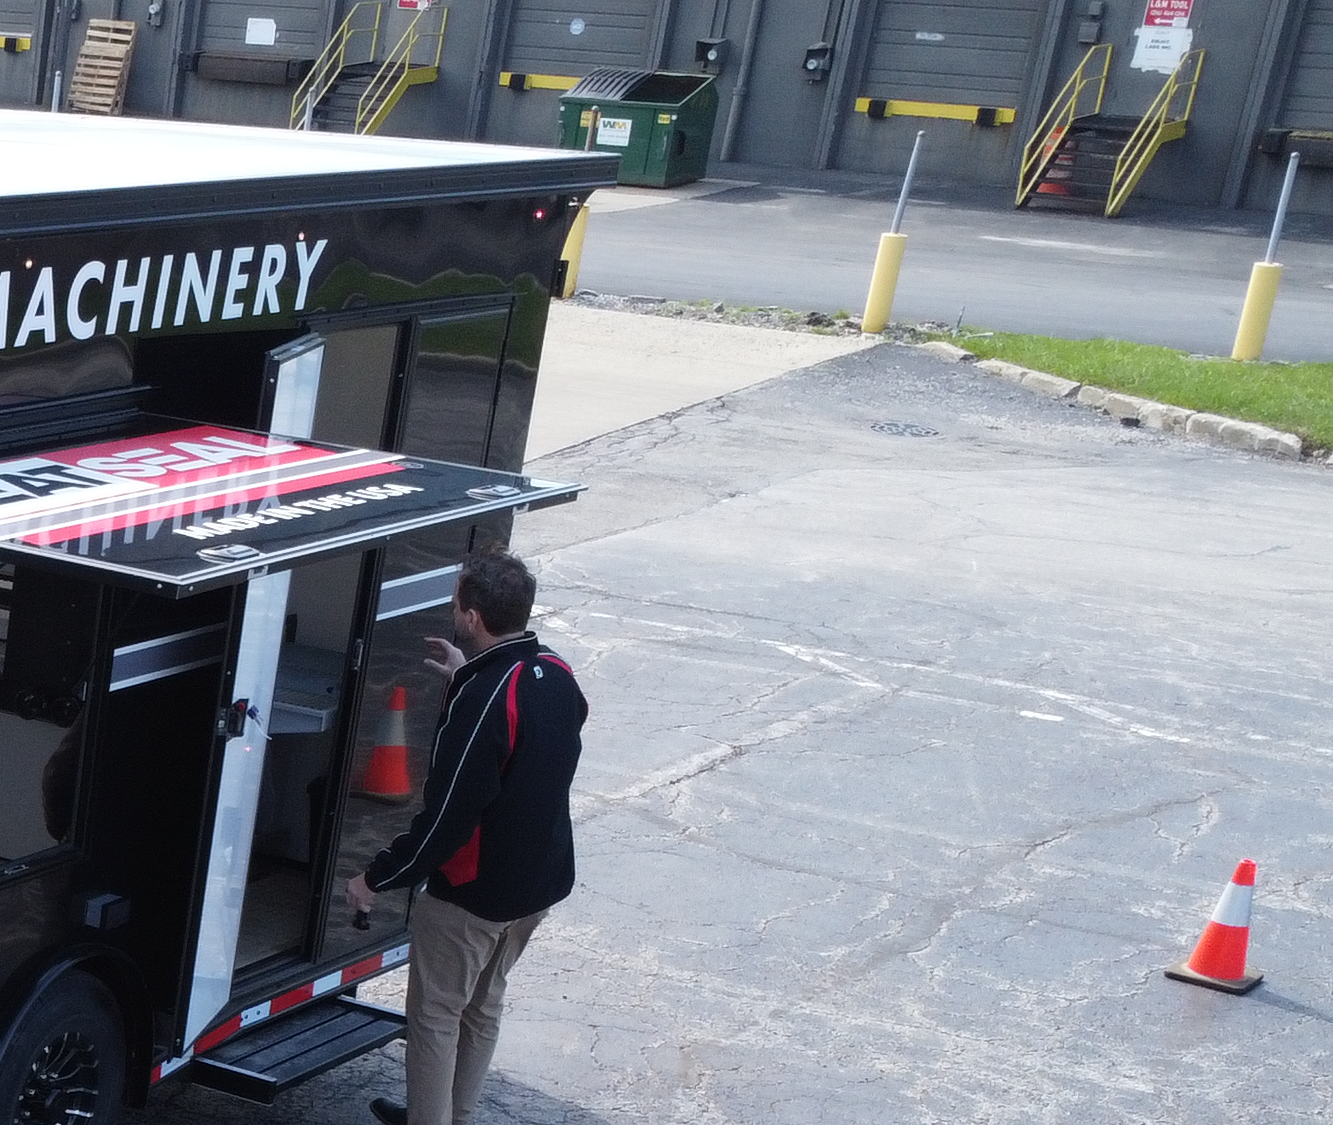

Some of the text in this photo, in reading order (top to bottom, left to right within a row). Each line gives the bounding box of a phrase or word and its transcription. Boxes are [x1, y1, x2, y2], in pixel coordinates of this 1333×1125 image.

[1170, 0, 1189, 10] TOOL
[172, 483, 425, 541] MADE IN THE USA
